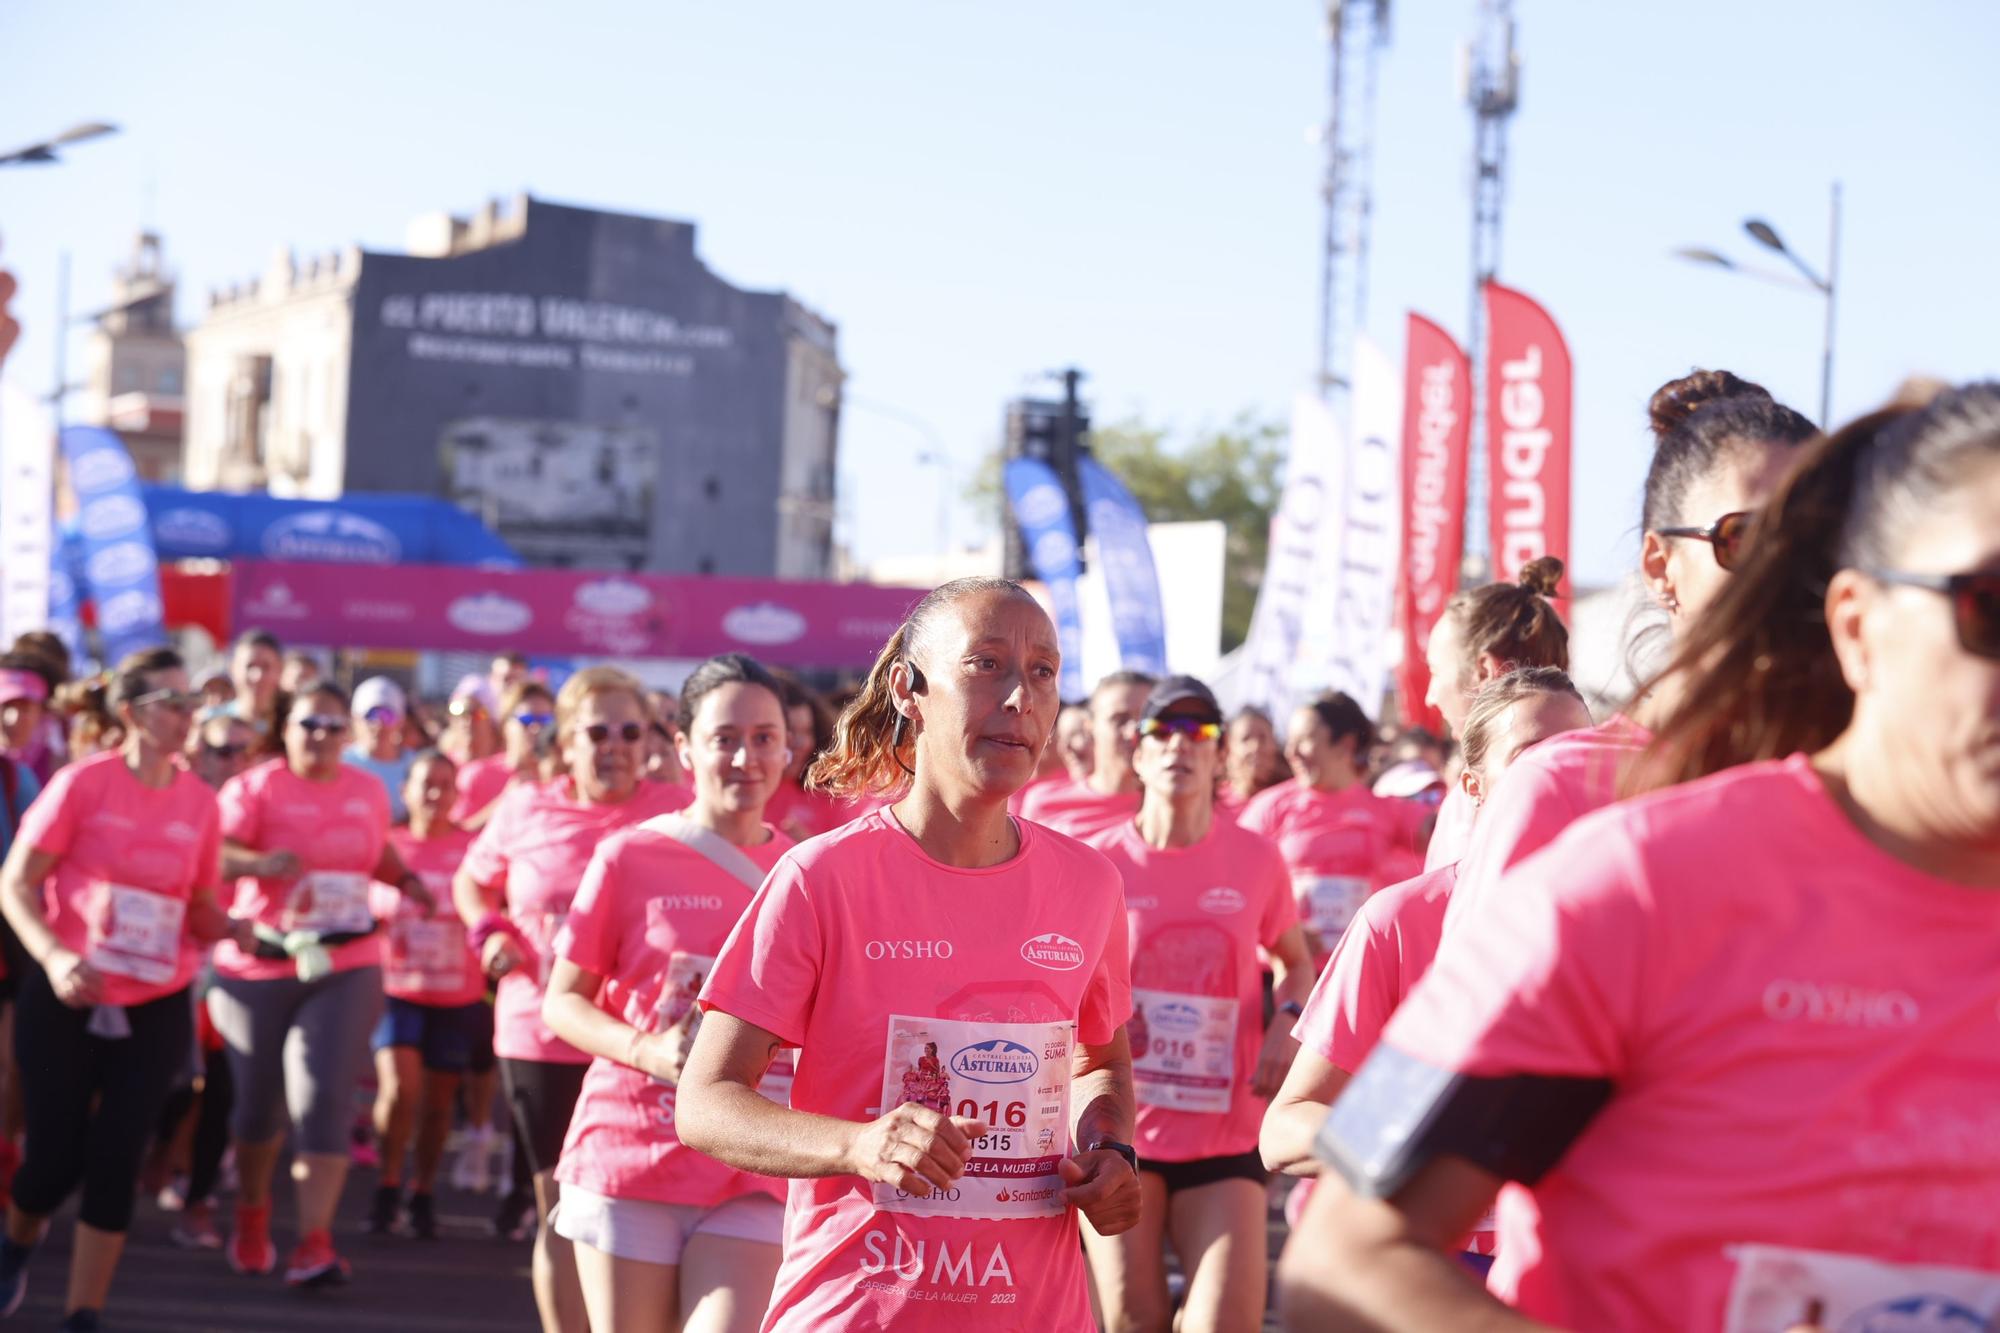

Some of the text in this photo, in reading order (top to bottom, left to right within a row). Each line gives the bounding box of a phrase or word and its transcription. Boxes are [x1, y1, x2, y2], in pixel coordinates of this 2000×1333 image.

[865, 940, 953, 960] OYSHO
[1044, 1048, 1066, 1060] SUMA
[957, 1099, 1026, 1127] 016
[964, 1162, 981, 1172] DE
[983, 1163, 999, 1173] LA
[1002, 1163, 1036, 1174] MUJER
[896, 1187, 960, 1202] OHO
[1012, 1188, 1055, 1202] Santander
[860, 1230, 1014, 1287] SUMA
[908, 1289, 924, 1300] DE
[925, 1291, 938, 1301] LA
[942, 1292, 978, 1304] MUJER
[990, 1293, 1017, 1304] 2023
